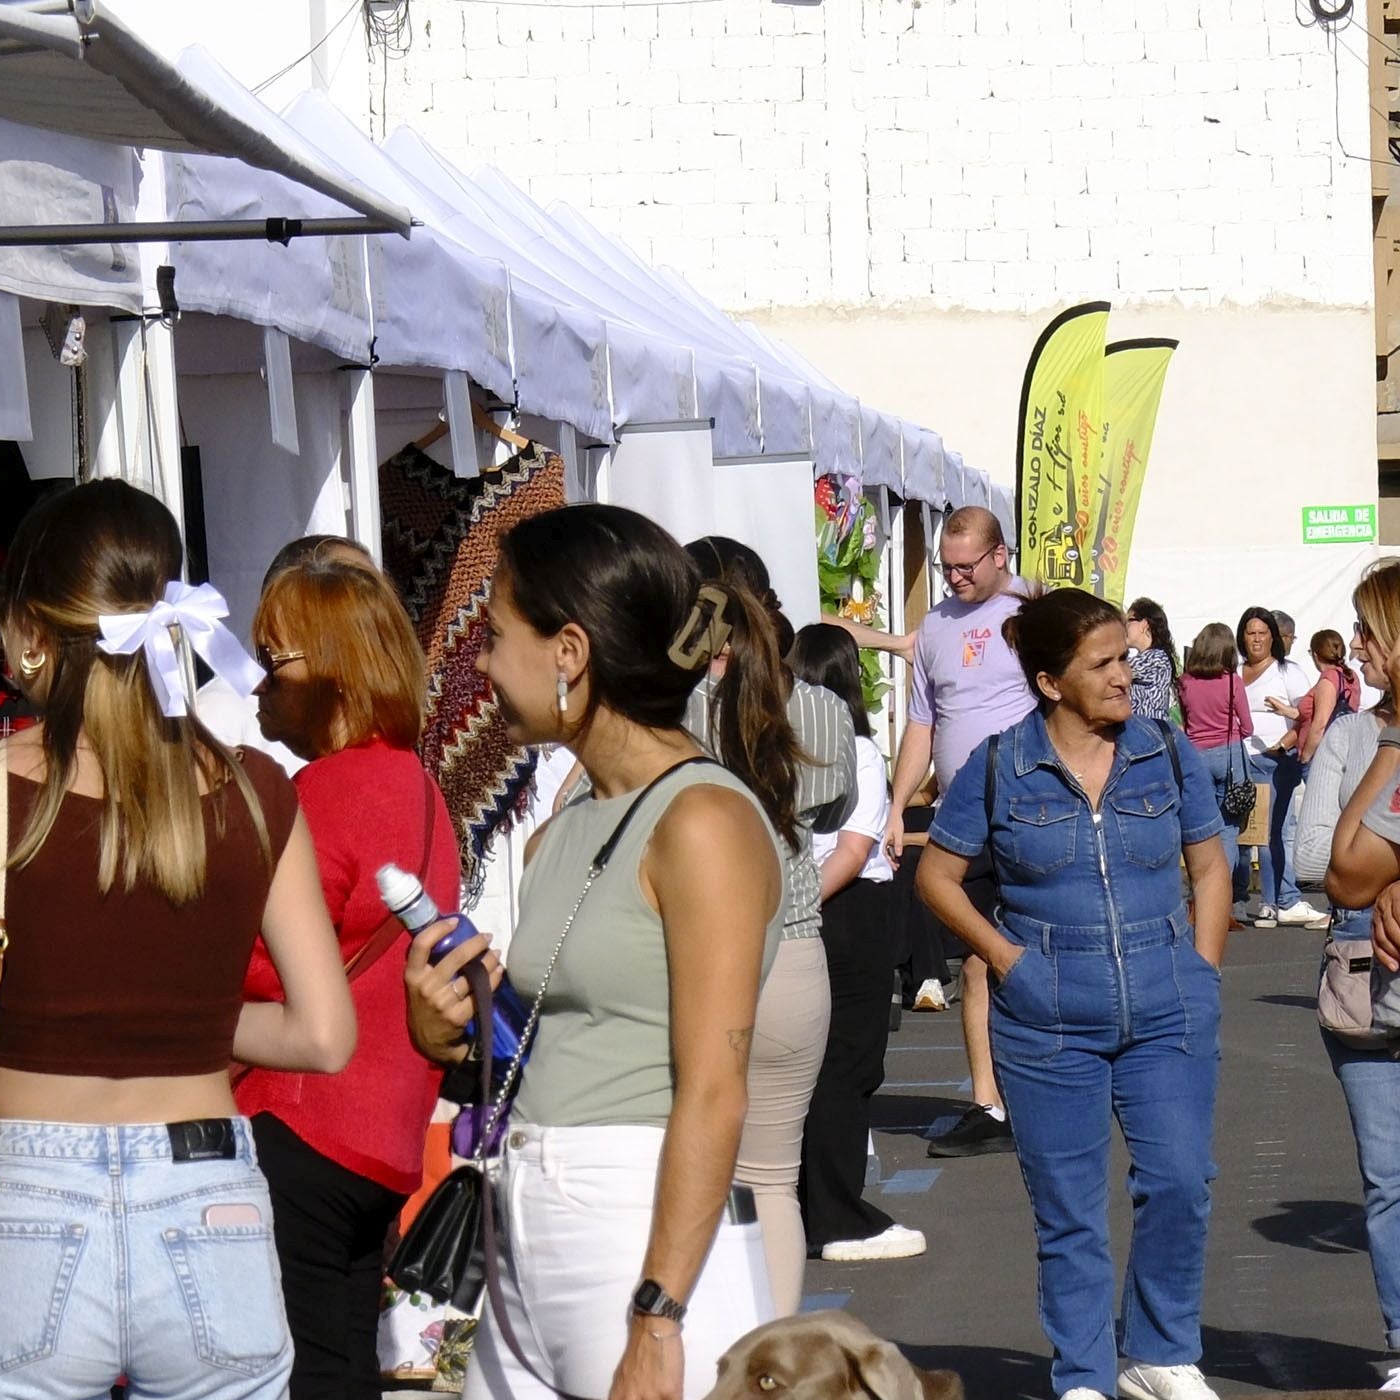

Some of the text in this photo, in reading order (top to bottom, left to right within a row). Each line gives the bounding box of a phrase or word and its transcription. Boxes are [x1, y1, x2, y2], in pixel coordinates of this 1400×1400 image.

[1077, 409, 1098, 468] contigo
[1028, 405, 1047, 550] GONZALO DÍAZ
[1306, 525, 1373, 539] EMERGENCIA
[1308, 507, 1370, 524] SALIDA DE
